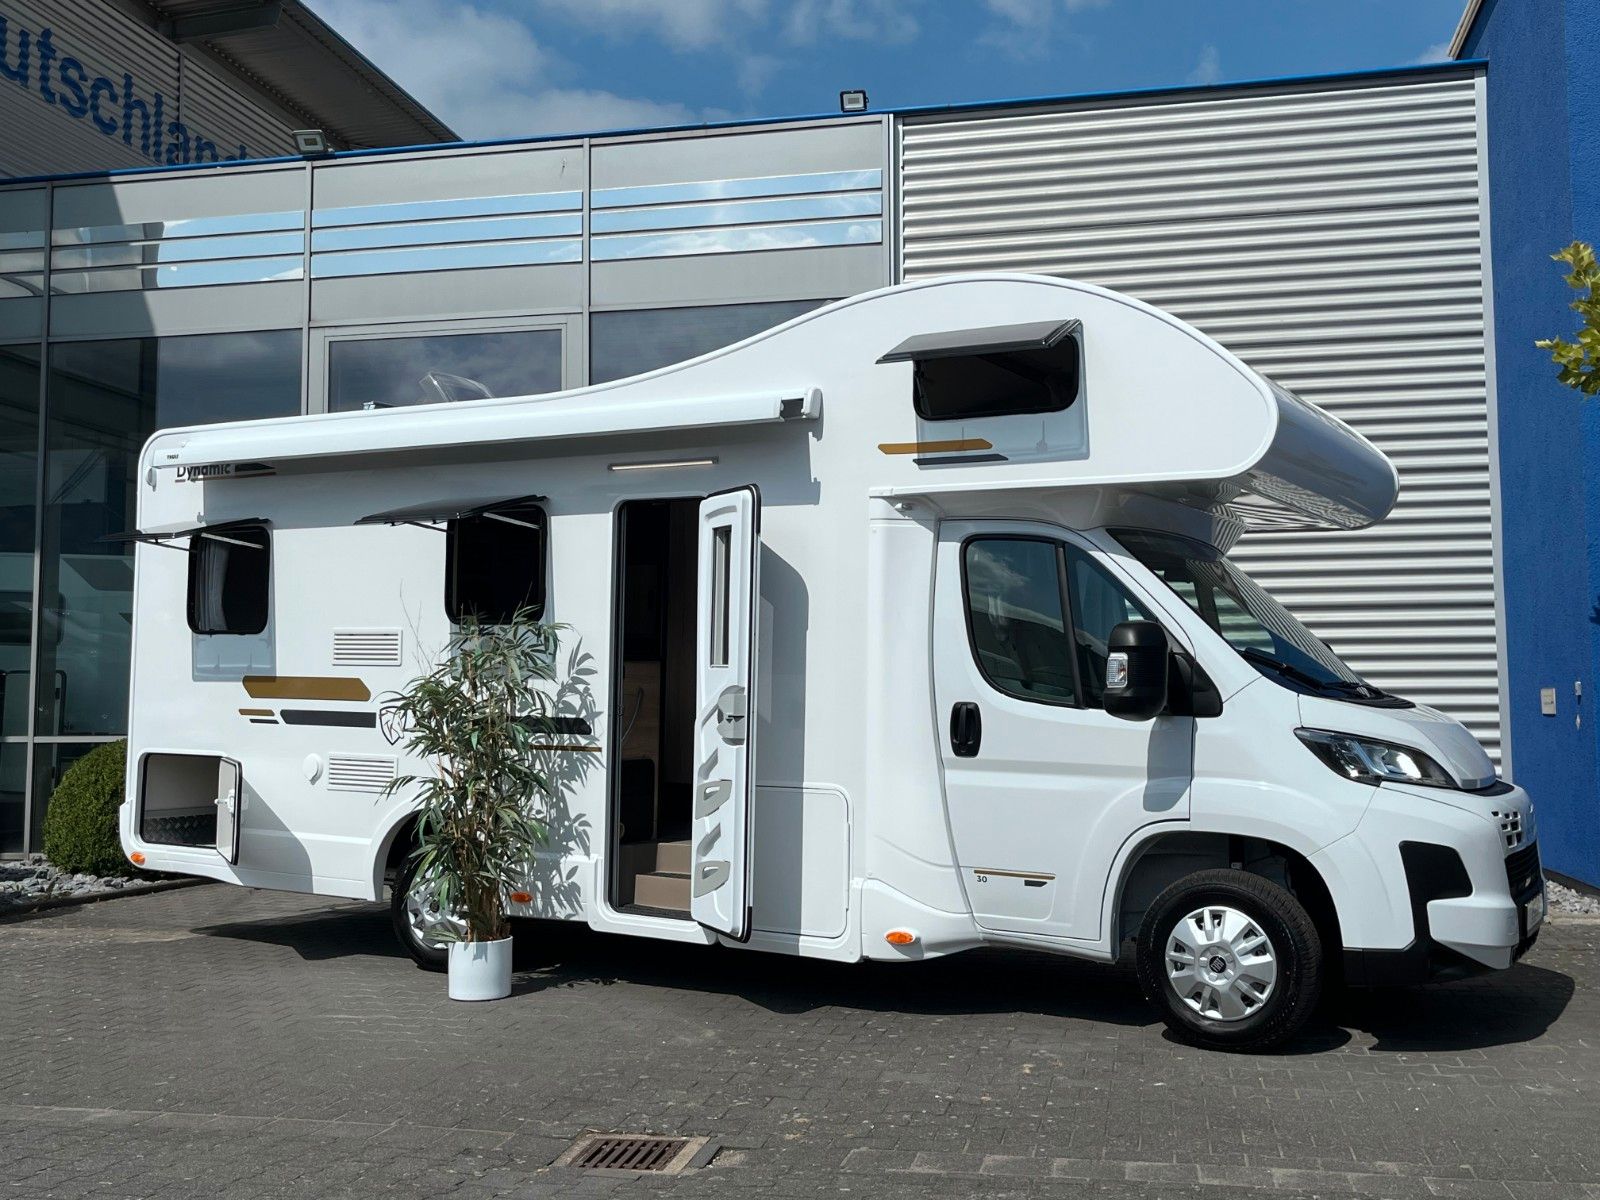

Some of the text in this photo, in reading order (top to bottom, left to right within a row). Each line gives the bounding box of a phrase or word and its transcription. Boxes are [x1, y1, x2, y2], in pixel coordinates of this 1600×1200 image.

[0, 16, 247, 165] utschlan
[177, 463, 231, 480] Dynamic
[976, 875, 988, 883] 30
